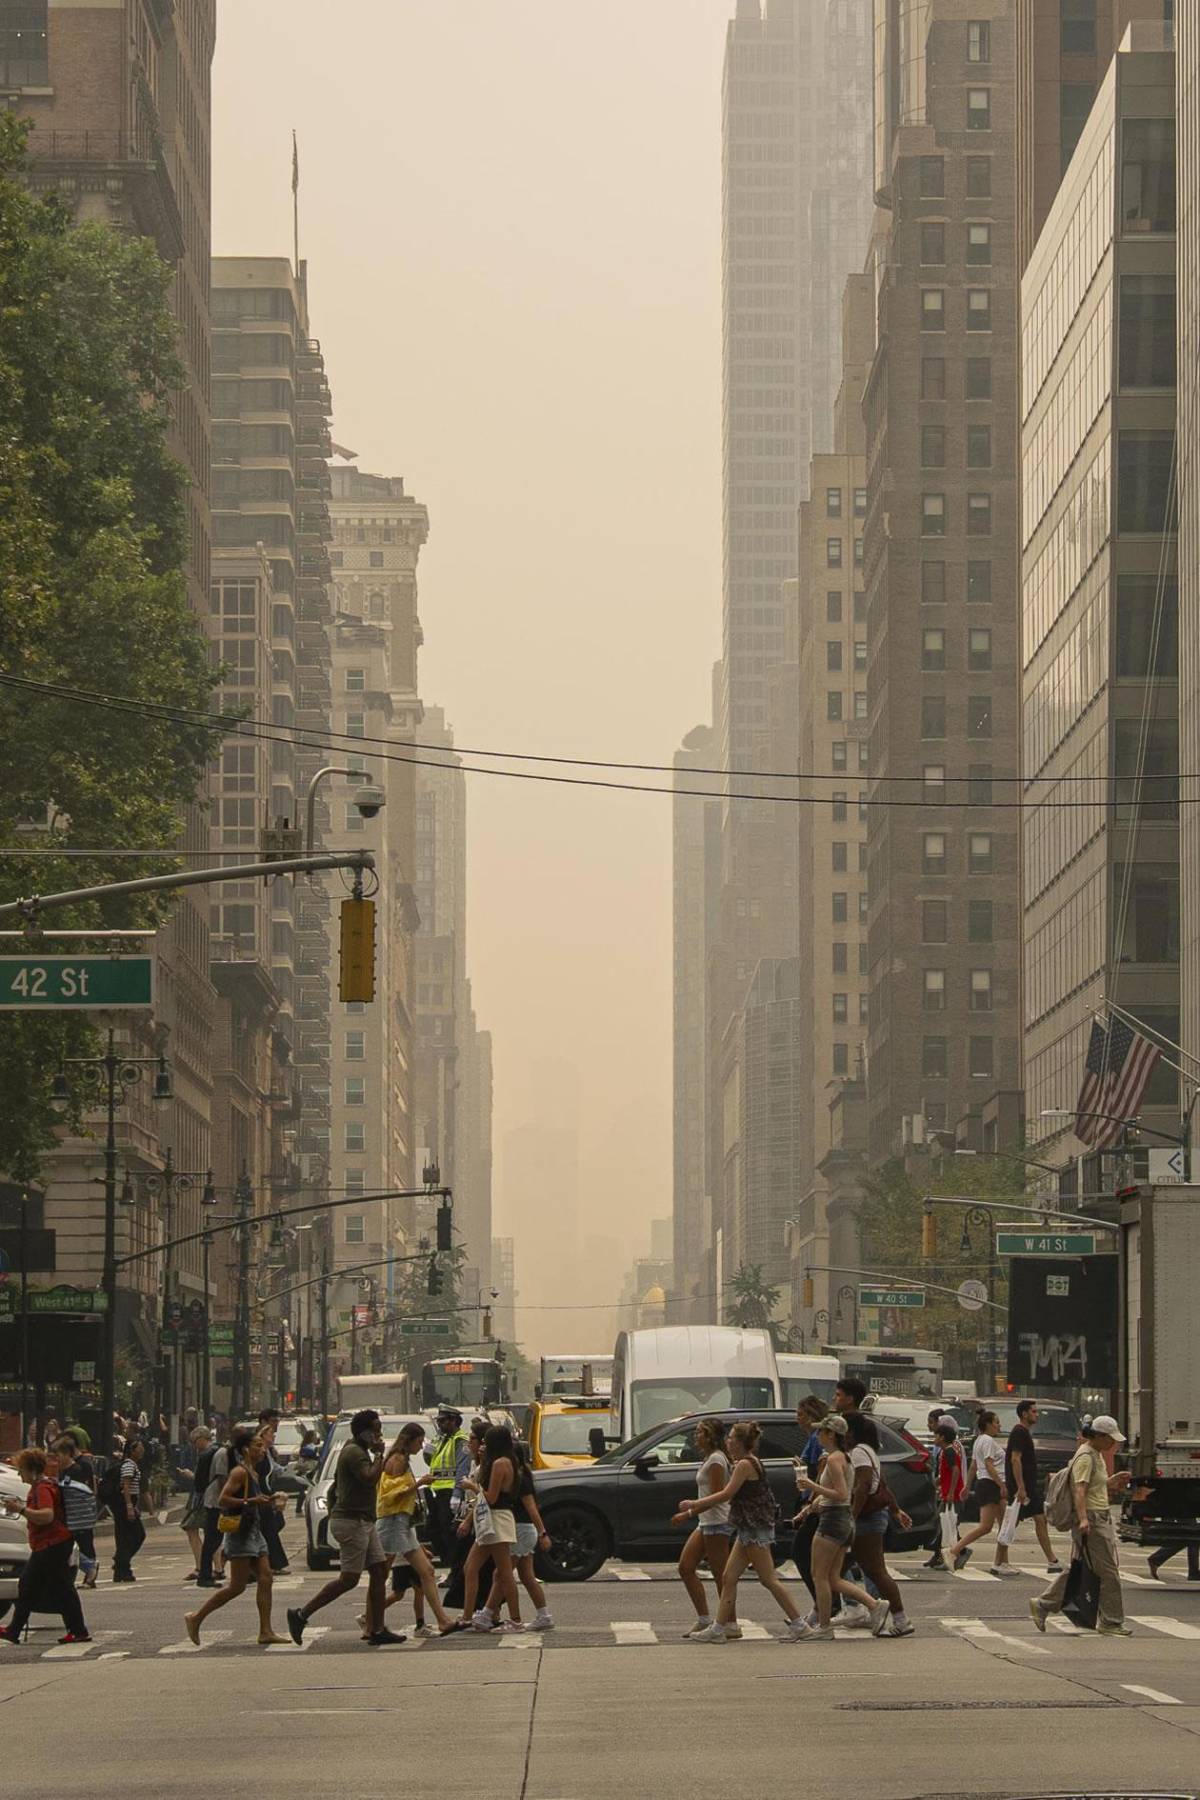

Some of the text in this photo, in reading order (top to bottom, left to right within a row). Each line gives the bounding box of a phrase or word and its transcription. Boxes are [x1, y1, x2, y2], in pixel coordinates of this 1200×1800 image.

[11, 967, 88, 996] 42 St
[1024, 1238, 1067, 1252] W 41 St
[34, 1297, 62, 1308] West
[875, 1294, 908, 1305] W 40 St
